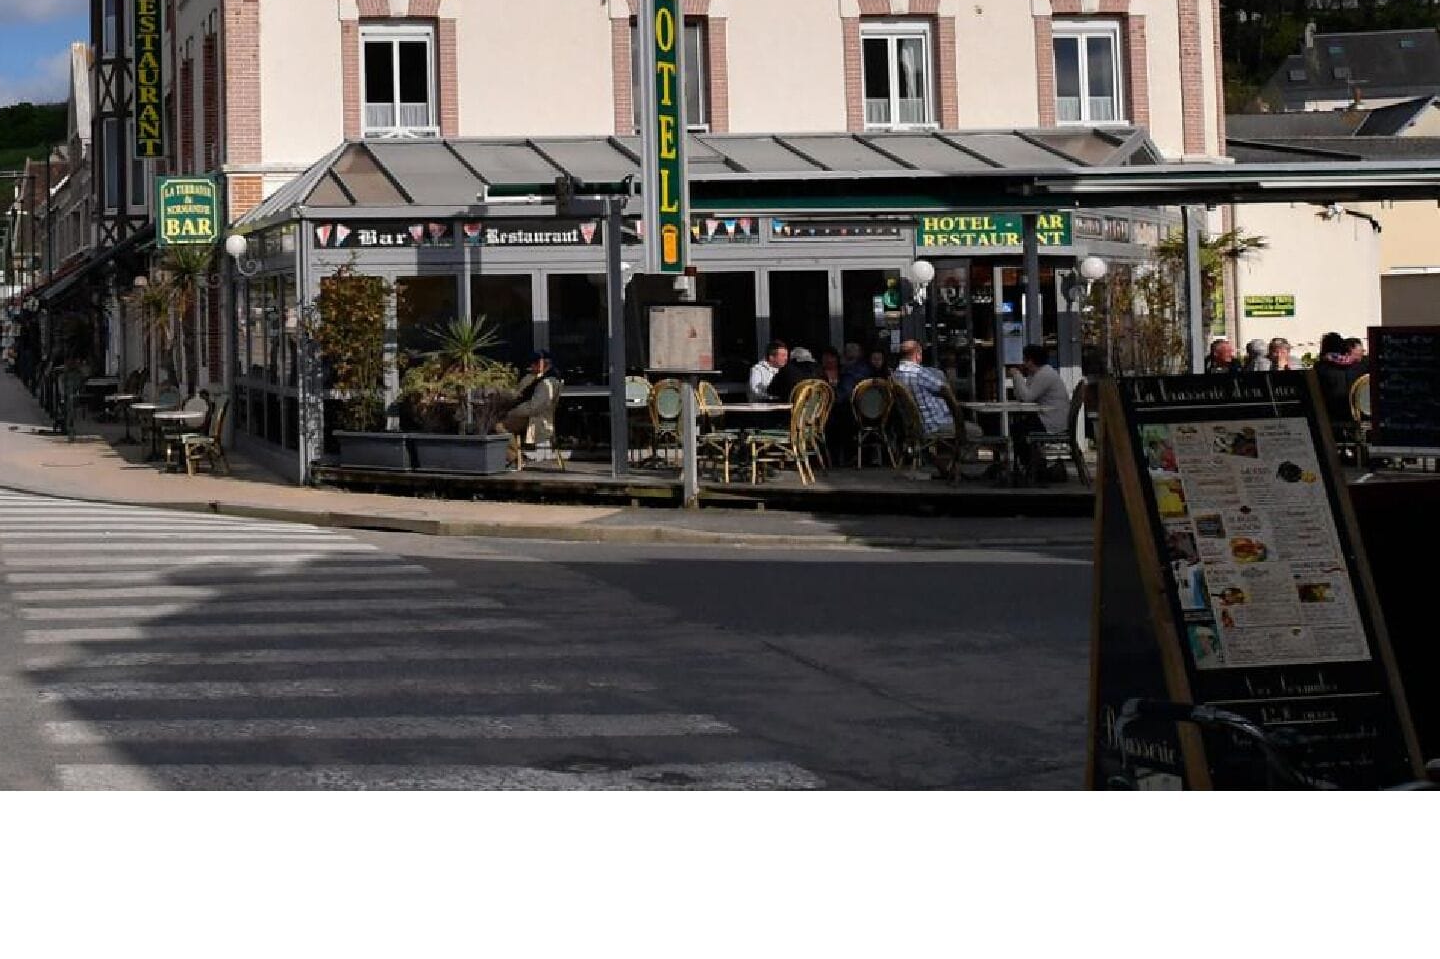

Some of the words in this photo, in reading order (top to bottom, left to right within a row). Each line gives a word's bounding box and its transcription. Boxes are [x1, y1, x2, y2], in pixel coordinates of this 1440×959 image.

[166, 217, 213, 236] BAR
[923, 215, 997, 231] HOTEL
[1034, 214, 1064, 229] AR
[357, 228, 407, 246] Bar
[486, 227, 579, 245] Restaurant
[923, 231, 1065, 247] RESTAURNT
